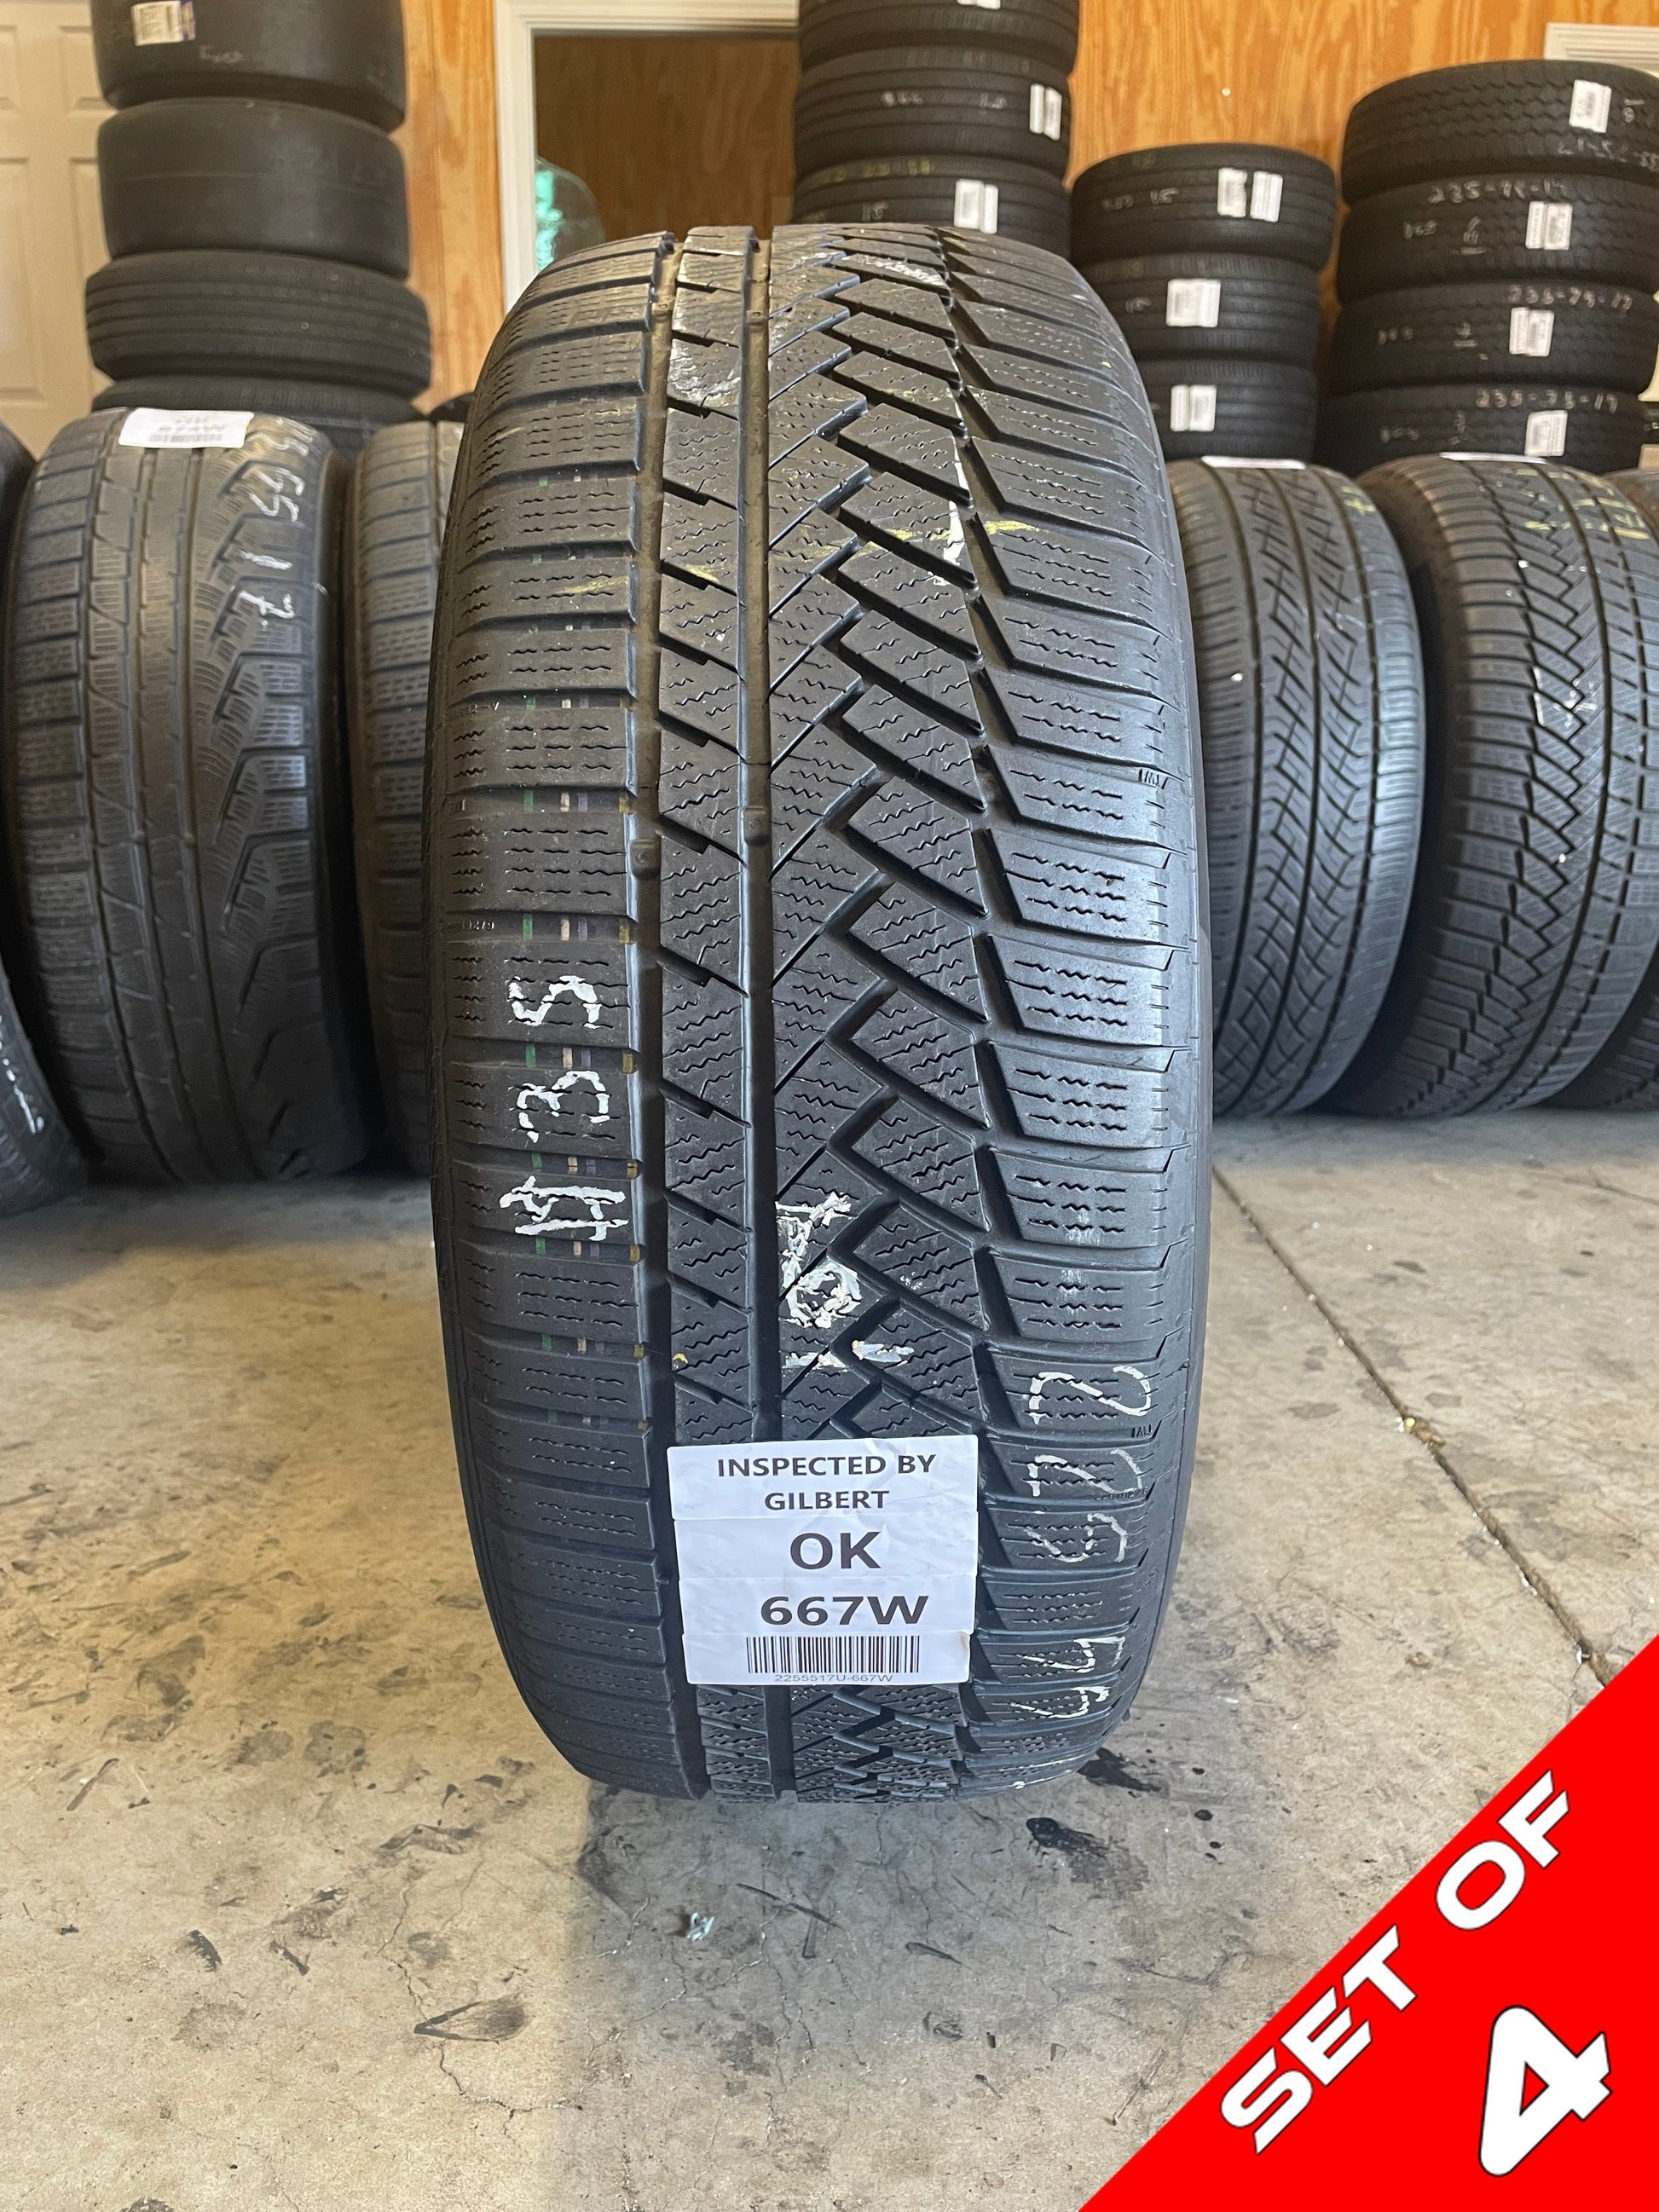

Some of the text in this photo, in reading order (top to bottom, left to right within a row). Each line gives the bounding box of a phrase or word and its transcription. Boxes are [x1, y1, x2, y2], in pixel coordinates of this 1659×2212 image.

[717, 1453, 937, 1478] INSPECTED BY
[764, 1489, 890, 1511] GILBERT
[789, 1531, 882, 1570] OK
[760, 1595, 929, 1626] 667W
[774, 1673, 893, 1683] 2255517U-667W
